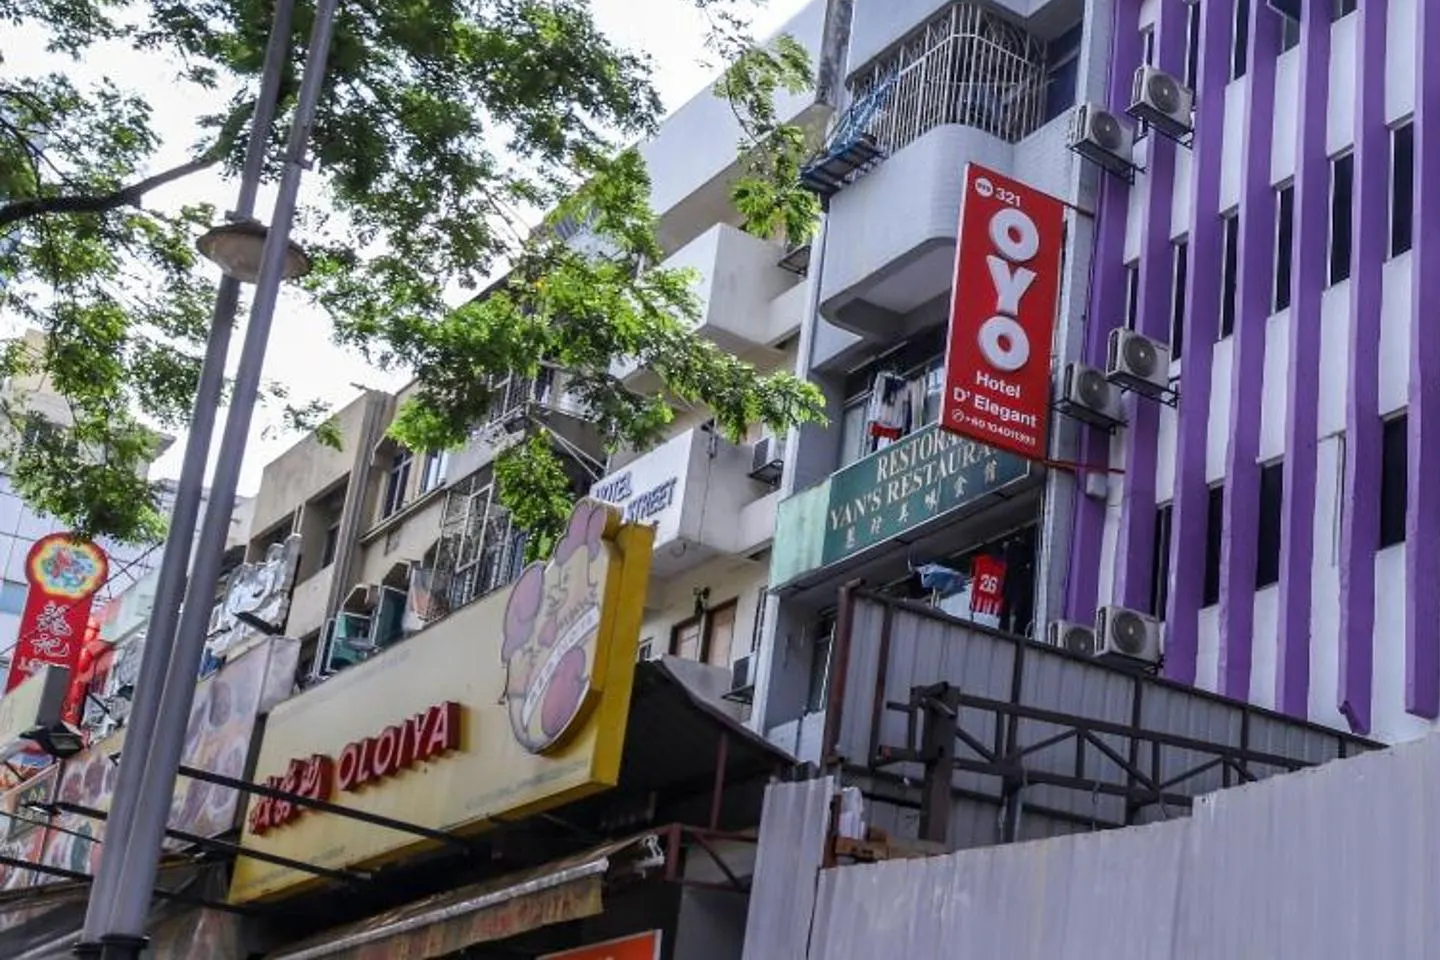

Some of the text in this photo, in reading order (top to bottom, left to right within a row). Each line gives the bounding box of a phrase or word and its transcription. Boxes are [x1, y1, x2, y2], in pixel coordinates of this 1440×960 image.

[995, 187, 1020, 208] 321
[978, 207, 1039, 371] OYO
[953, 386, 1037, 428] D' Elegant
[975, 370, 1021, 399] Hotel
[876, 426, 965, 483] RESTORA
[830, 442, 996, 531] YAN'S RESTAURA
[979, 574, 997, 595] 26
[337, 701, 459, 790] OLOIYA
